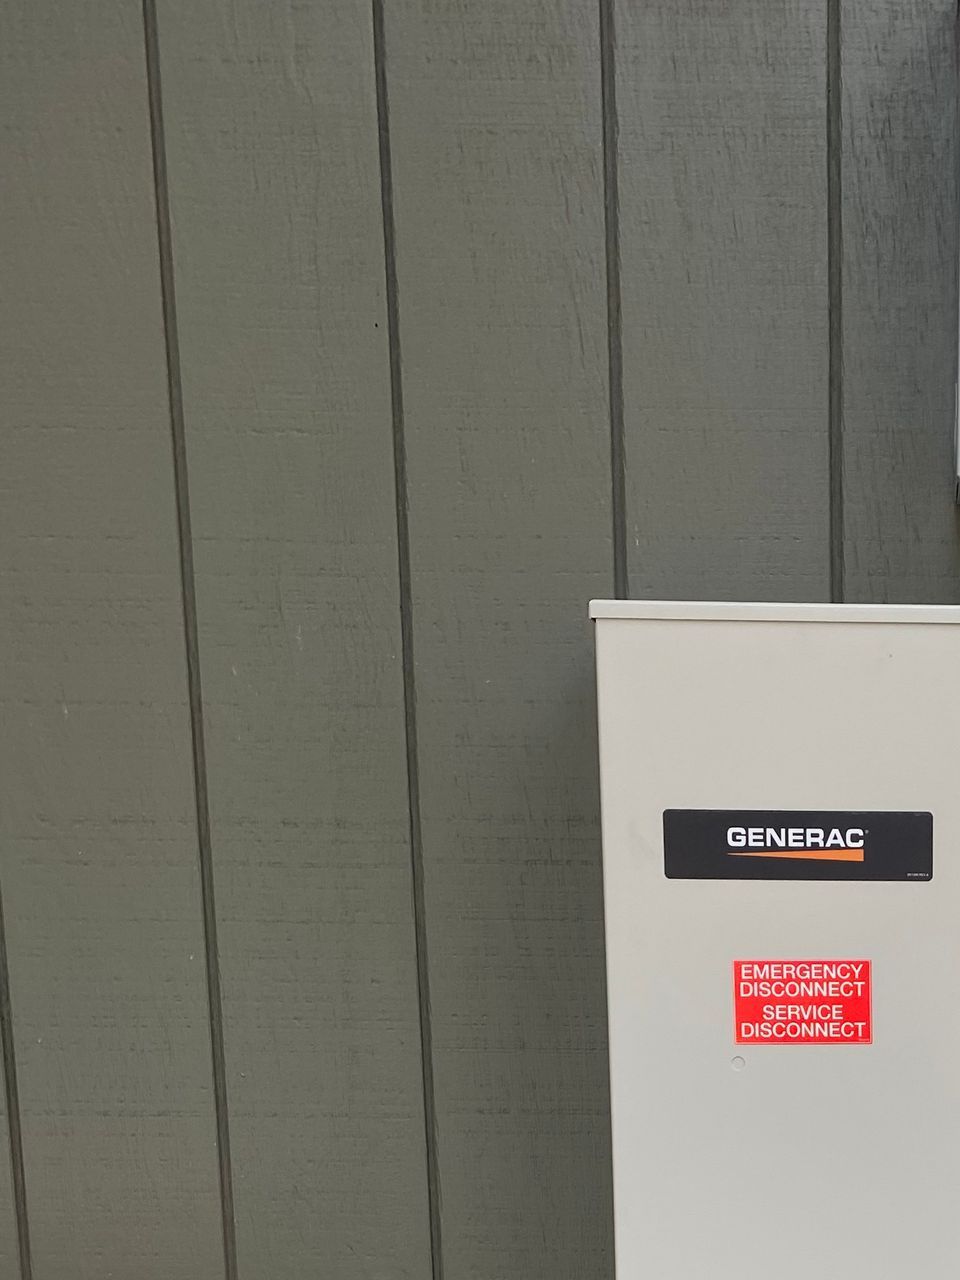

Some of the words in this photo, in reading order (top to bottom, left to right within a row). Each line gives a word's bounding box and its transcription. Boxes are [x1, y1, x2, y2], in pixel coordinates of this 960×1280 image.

[727, 826, 864, 848] GENERAC
[740, 964, 864, 980] EMERGENCY
[739, 981, 866, 997] DISCONNECT
[762, 1004, 844, 1020] SERVICE
[740, 1022, 867, 1038] DISCONNECT
